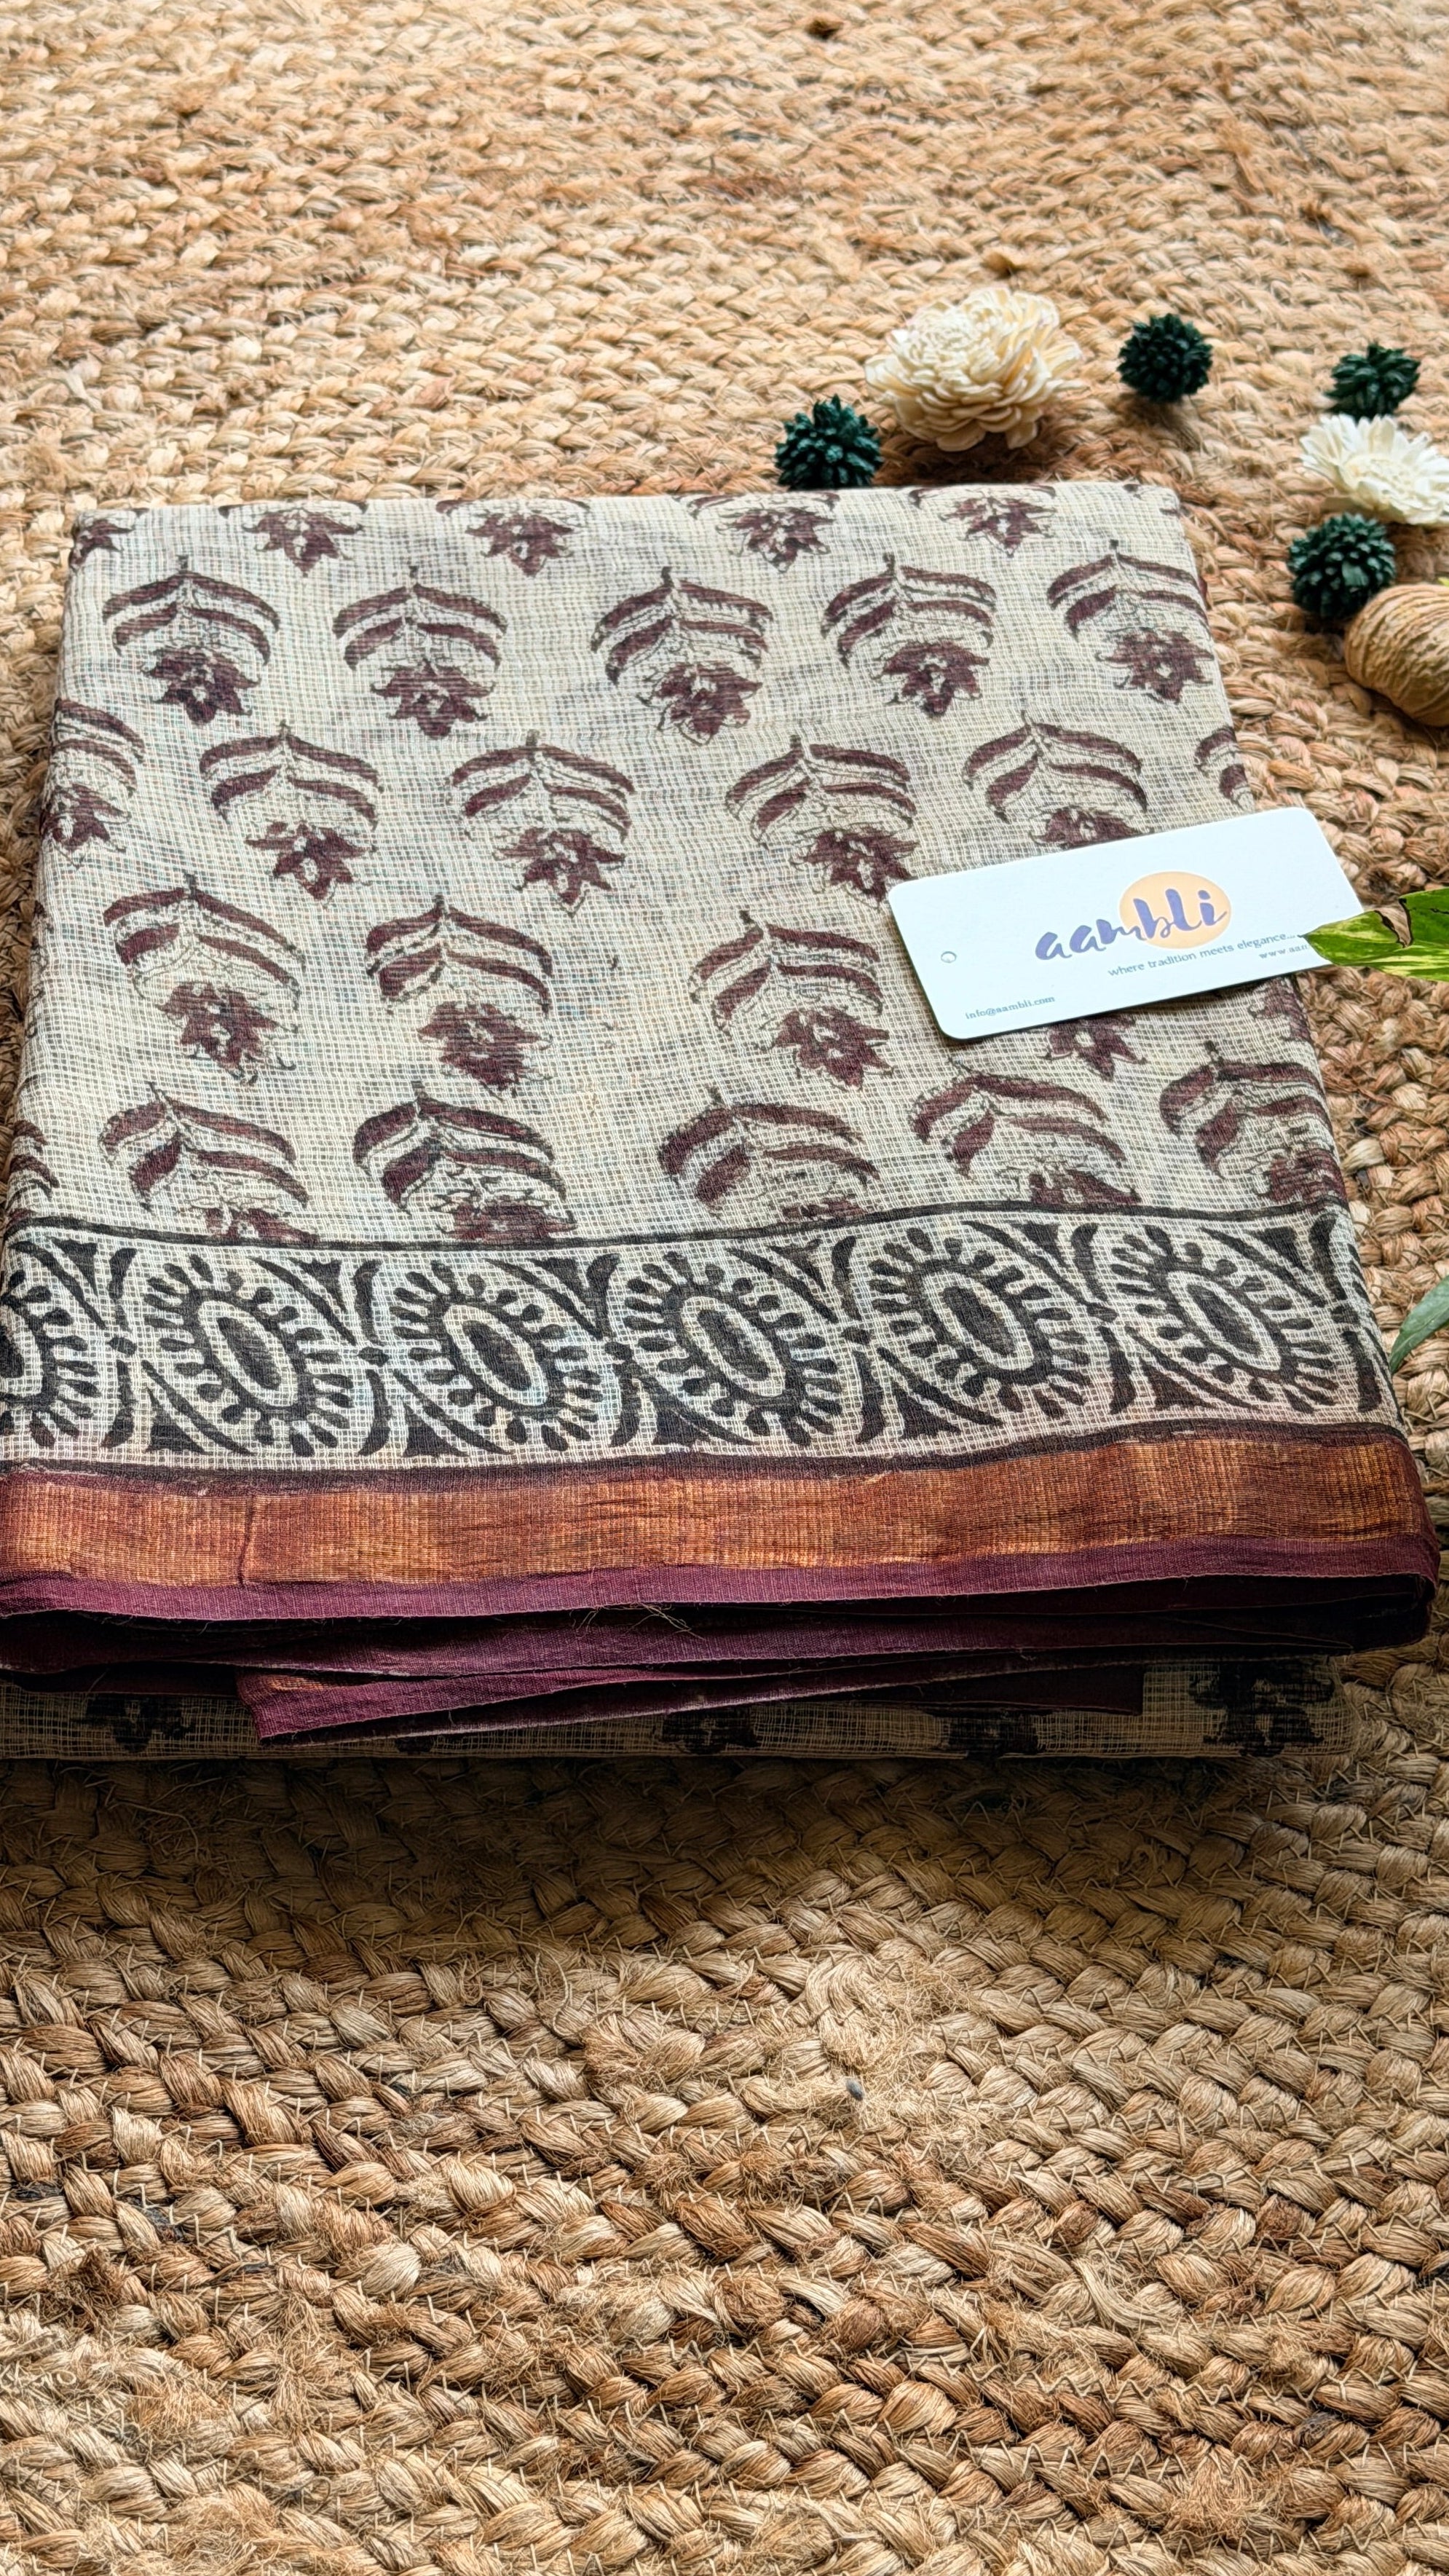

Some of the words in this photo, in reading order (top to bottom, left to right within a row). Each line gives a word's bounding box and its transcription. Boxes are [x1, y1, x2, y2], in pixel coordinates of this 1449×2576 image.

[1035, 889, 1228, 961] aambli
[1108, 963, 1145, 977] where
[1148, 952, 1197, 969] tradition
[1199, 945, 1234, 958] meets
[965, 996, 1056, 1020] info@aambli.com
